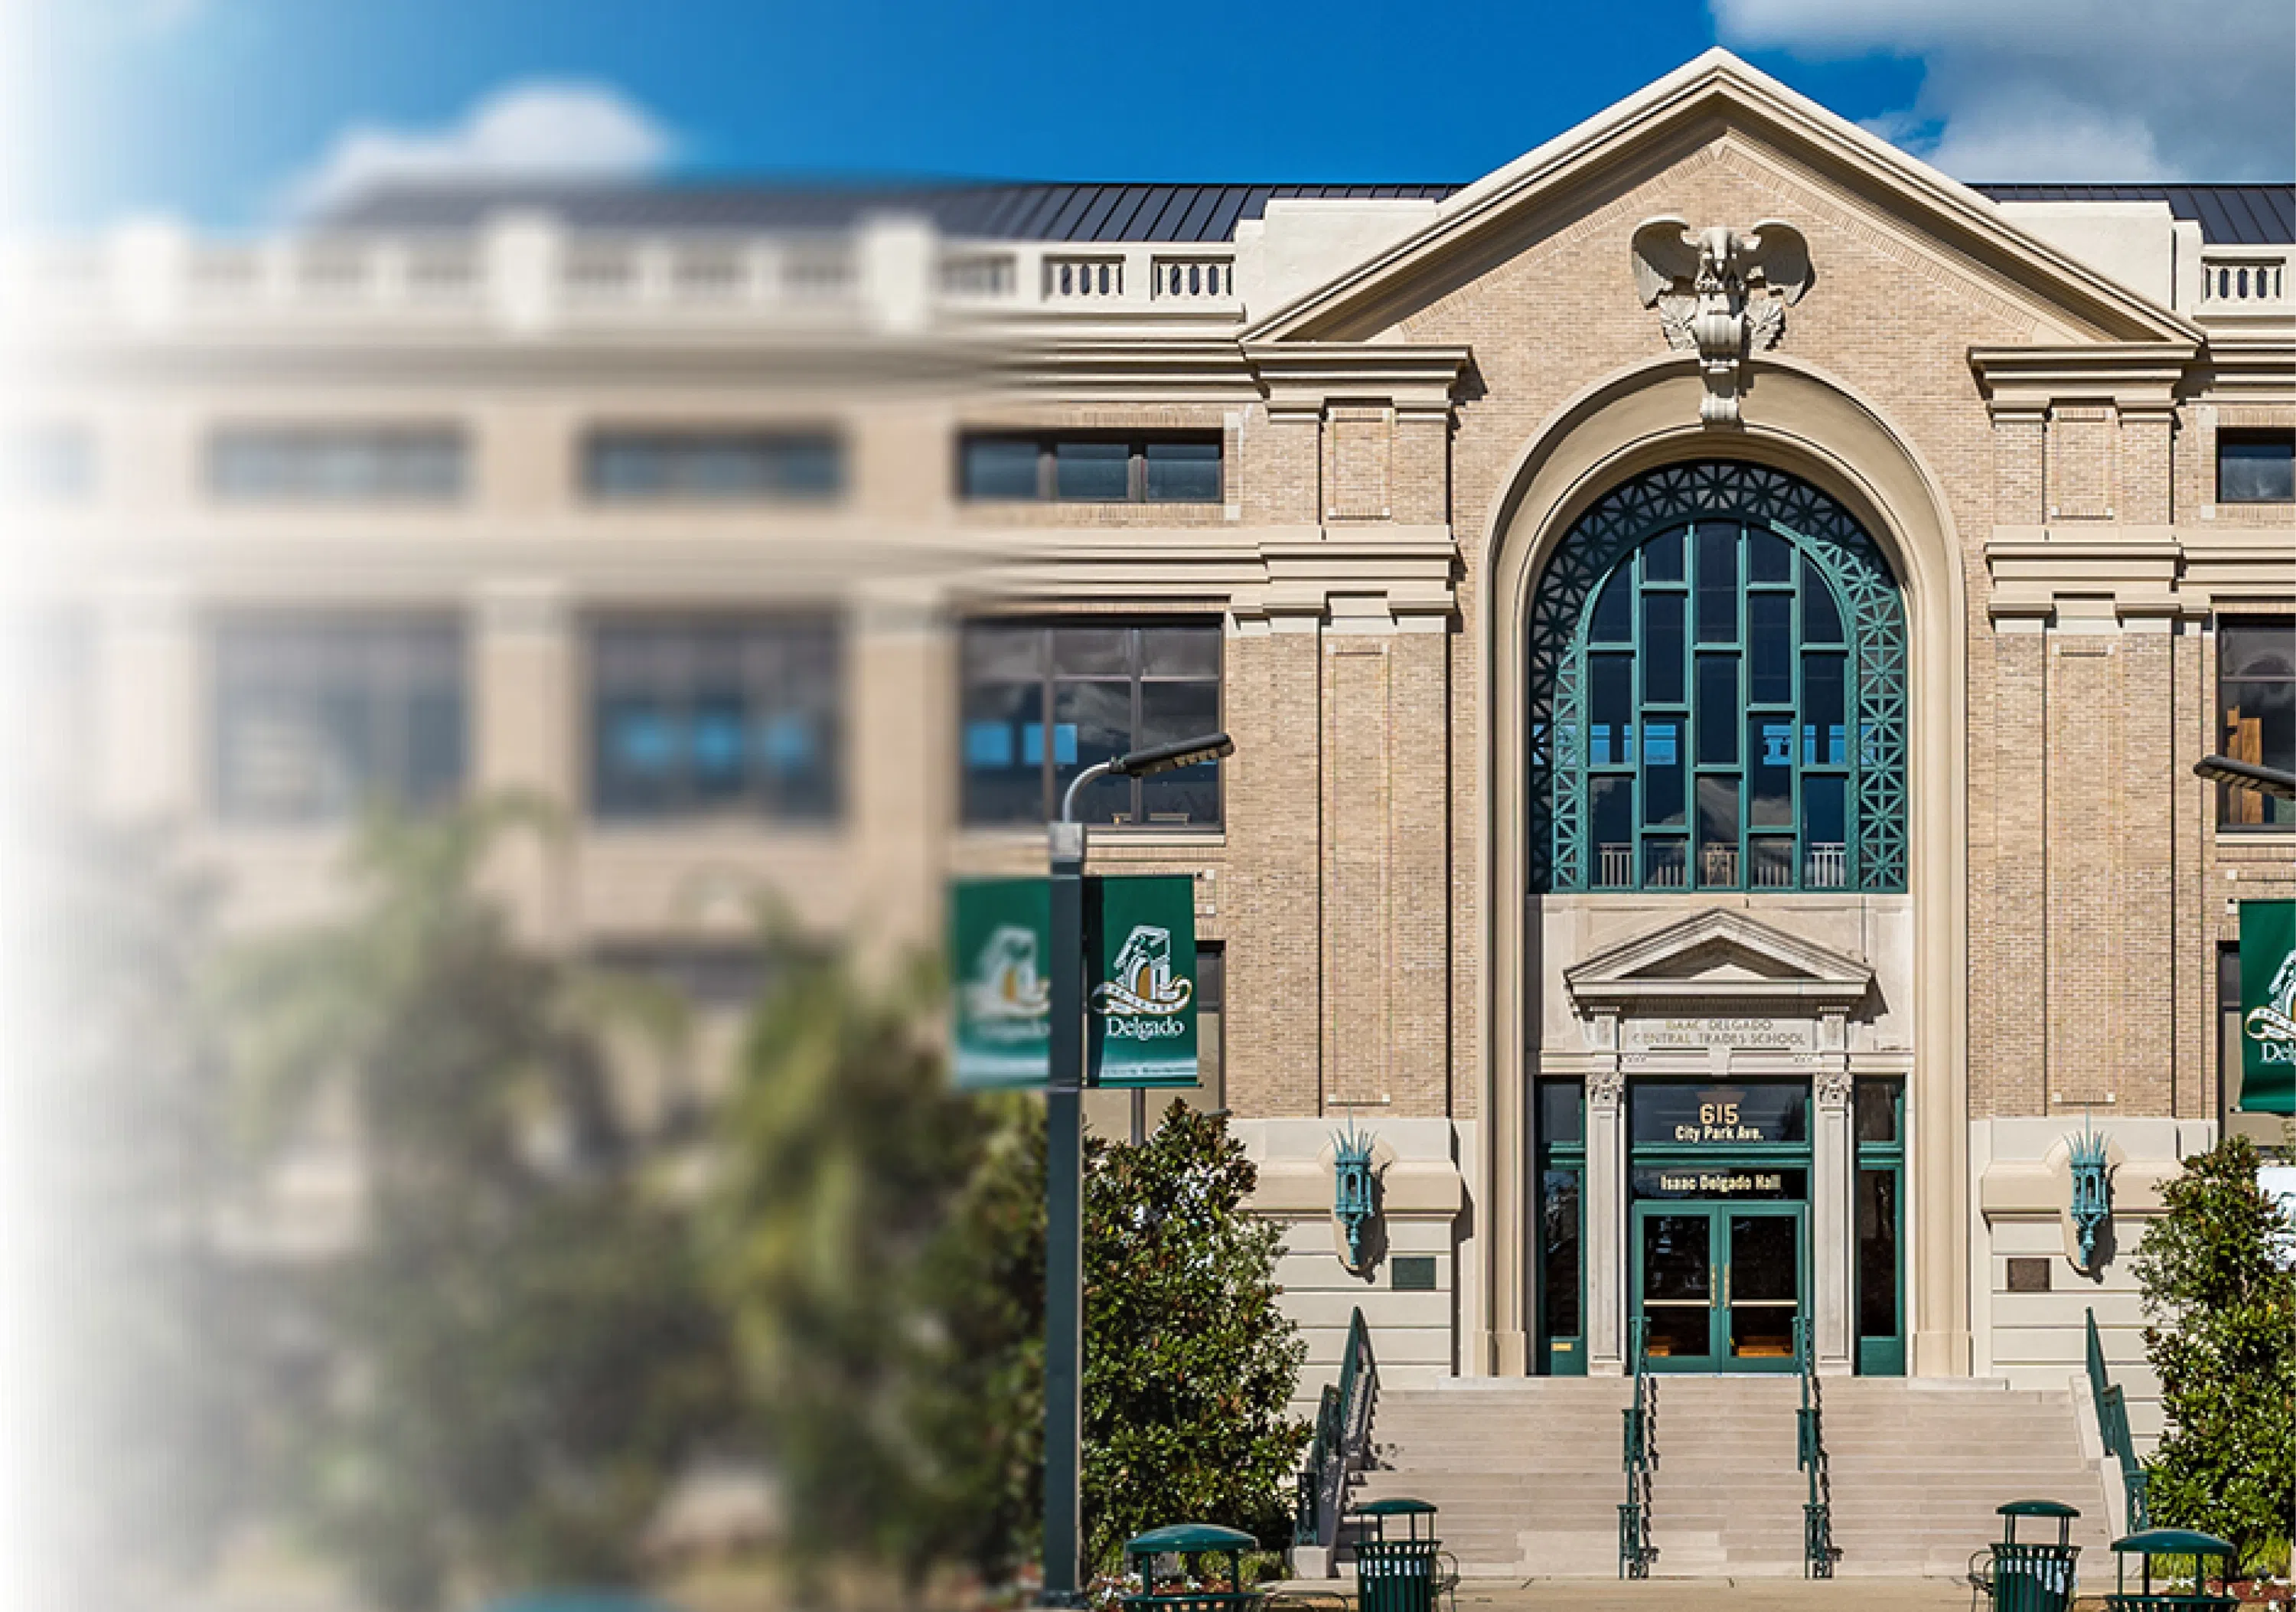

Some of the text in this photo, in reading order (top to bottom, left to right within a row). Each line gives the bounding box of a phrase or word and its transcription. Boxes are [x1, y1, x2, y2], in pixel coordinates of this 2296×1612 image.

[1106, 1016, 1185, 1041] Delgado
[1665, 1019, 1773, 1030] ISAAC DELGADO
[1632, 1033, 1805, 1045] CENTRAL TRADES SCHOOL
[1699, 1103, 1739, 1124] 615
[1675, 1125, 1763, 1143] City Park Ave.
[1661, 1174, 1781, 1193] Isaac Delgado Hall
